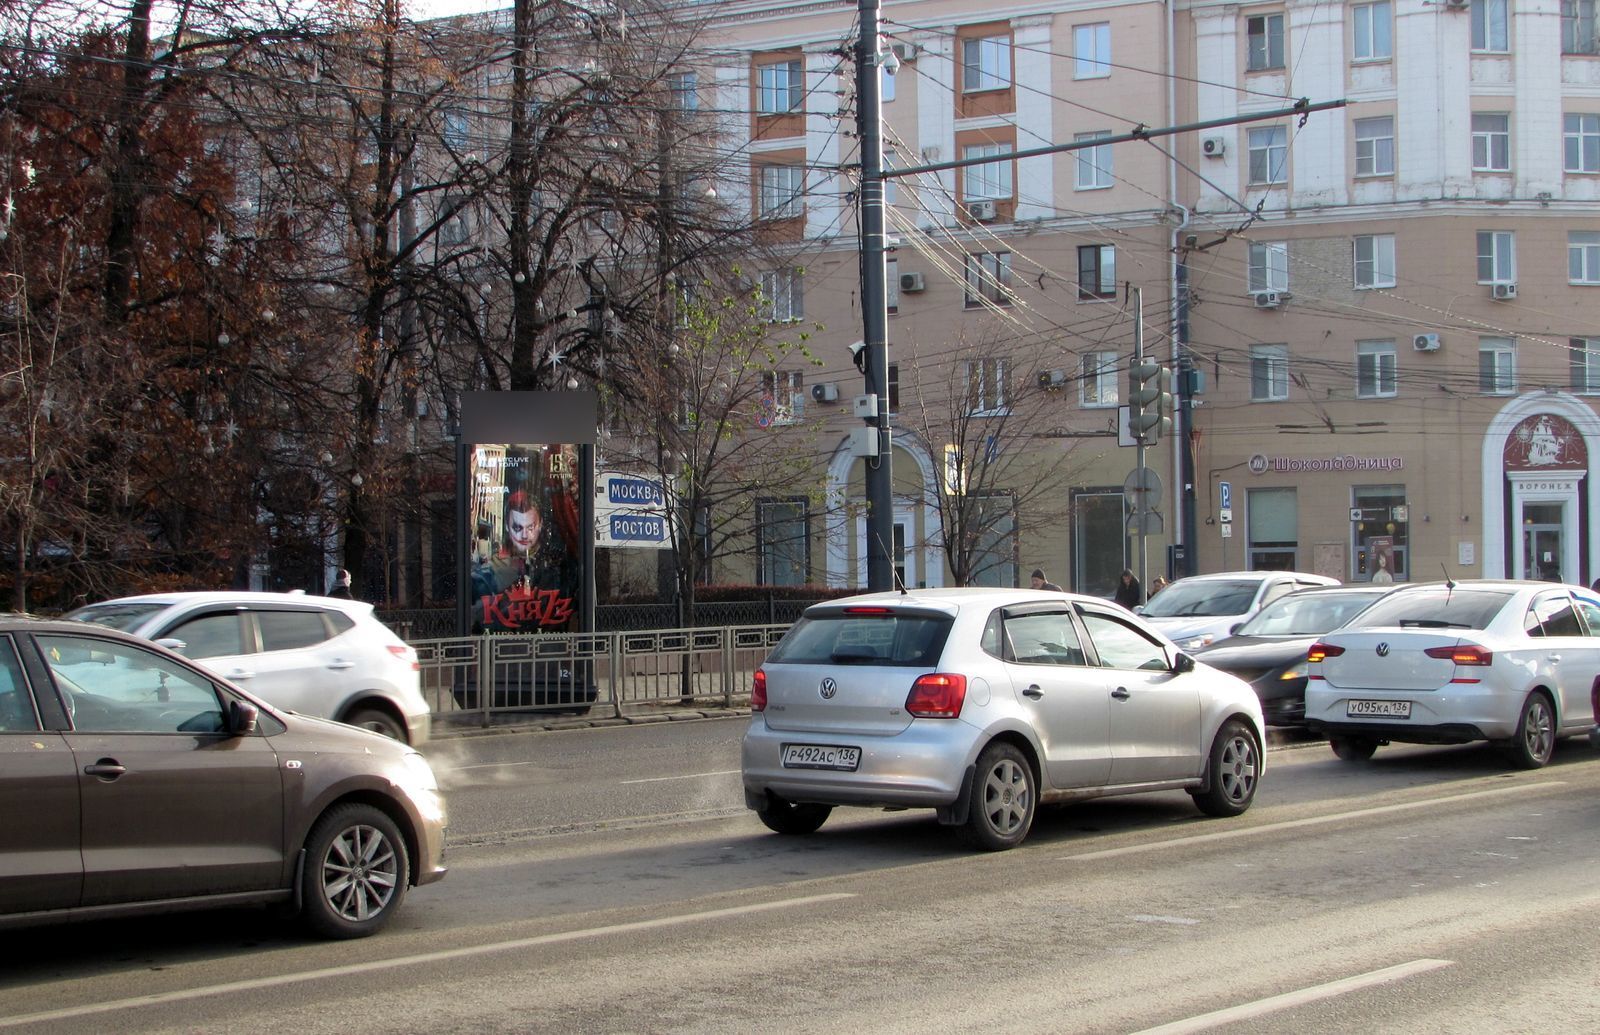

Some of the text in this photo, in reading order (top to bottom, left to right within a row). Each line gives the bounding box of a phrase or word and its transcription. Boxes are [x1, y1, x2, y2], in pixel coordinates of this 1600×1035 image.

[1274, 455, 1404, 472] Шоколадница
[476, 473, 491, 483] 16
[611, 484, 659, 500] МОСКВА
[614, 520, 660, 536] РОСТОВ
[1351, 702, 1407, 713] У095КА 136
[789, 748, 855, 763] Р492АС 136
